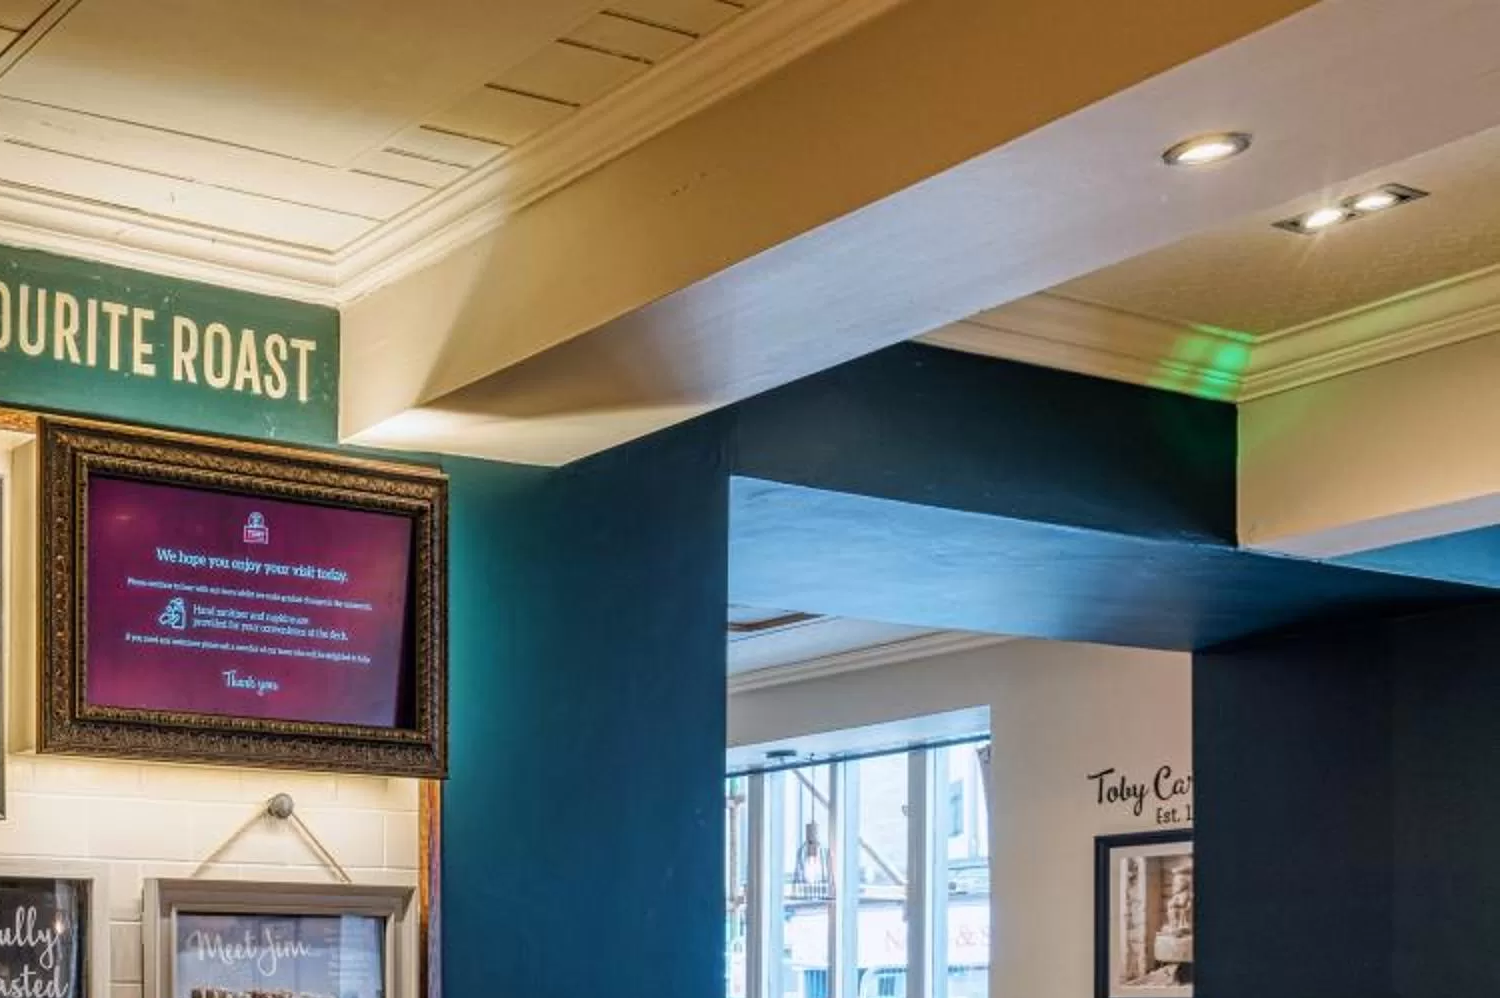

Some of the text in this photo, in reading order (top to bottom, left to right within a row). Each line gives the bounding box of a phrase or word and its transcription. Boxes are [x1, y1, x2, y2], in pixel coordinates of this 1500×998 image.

[173, 316, 316, 402] ROAST
[156, 547, 176, 562] We
[179, 550, 206, 568] hope
[208, 556, 230, 569] you
[231, 556, 261, 574] enjoy
[264, 562, 289, 576] your
[291, 564, 315, 578] visit
[221, 669, 257, 690] Thank
[1087, 768, 1149, 817] Toby
[188, 929, 257, 965] Meet
[257, 928, 311, 977] Jim
